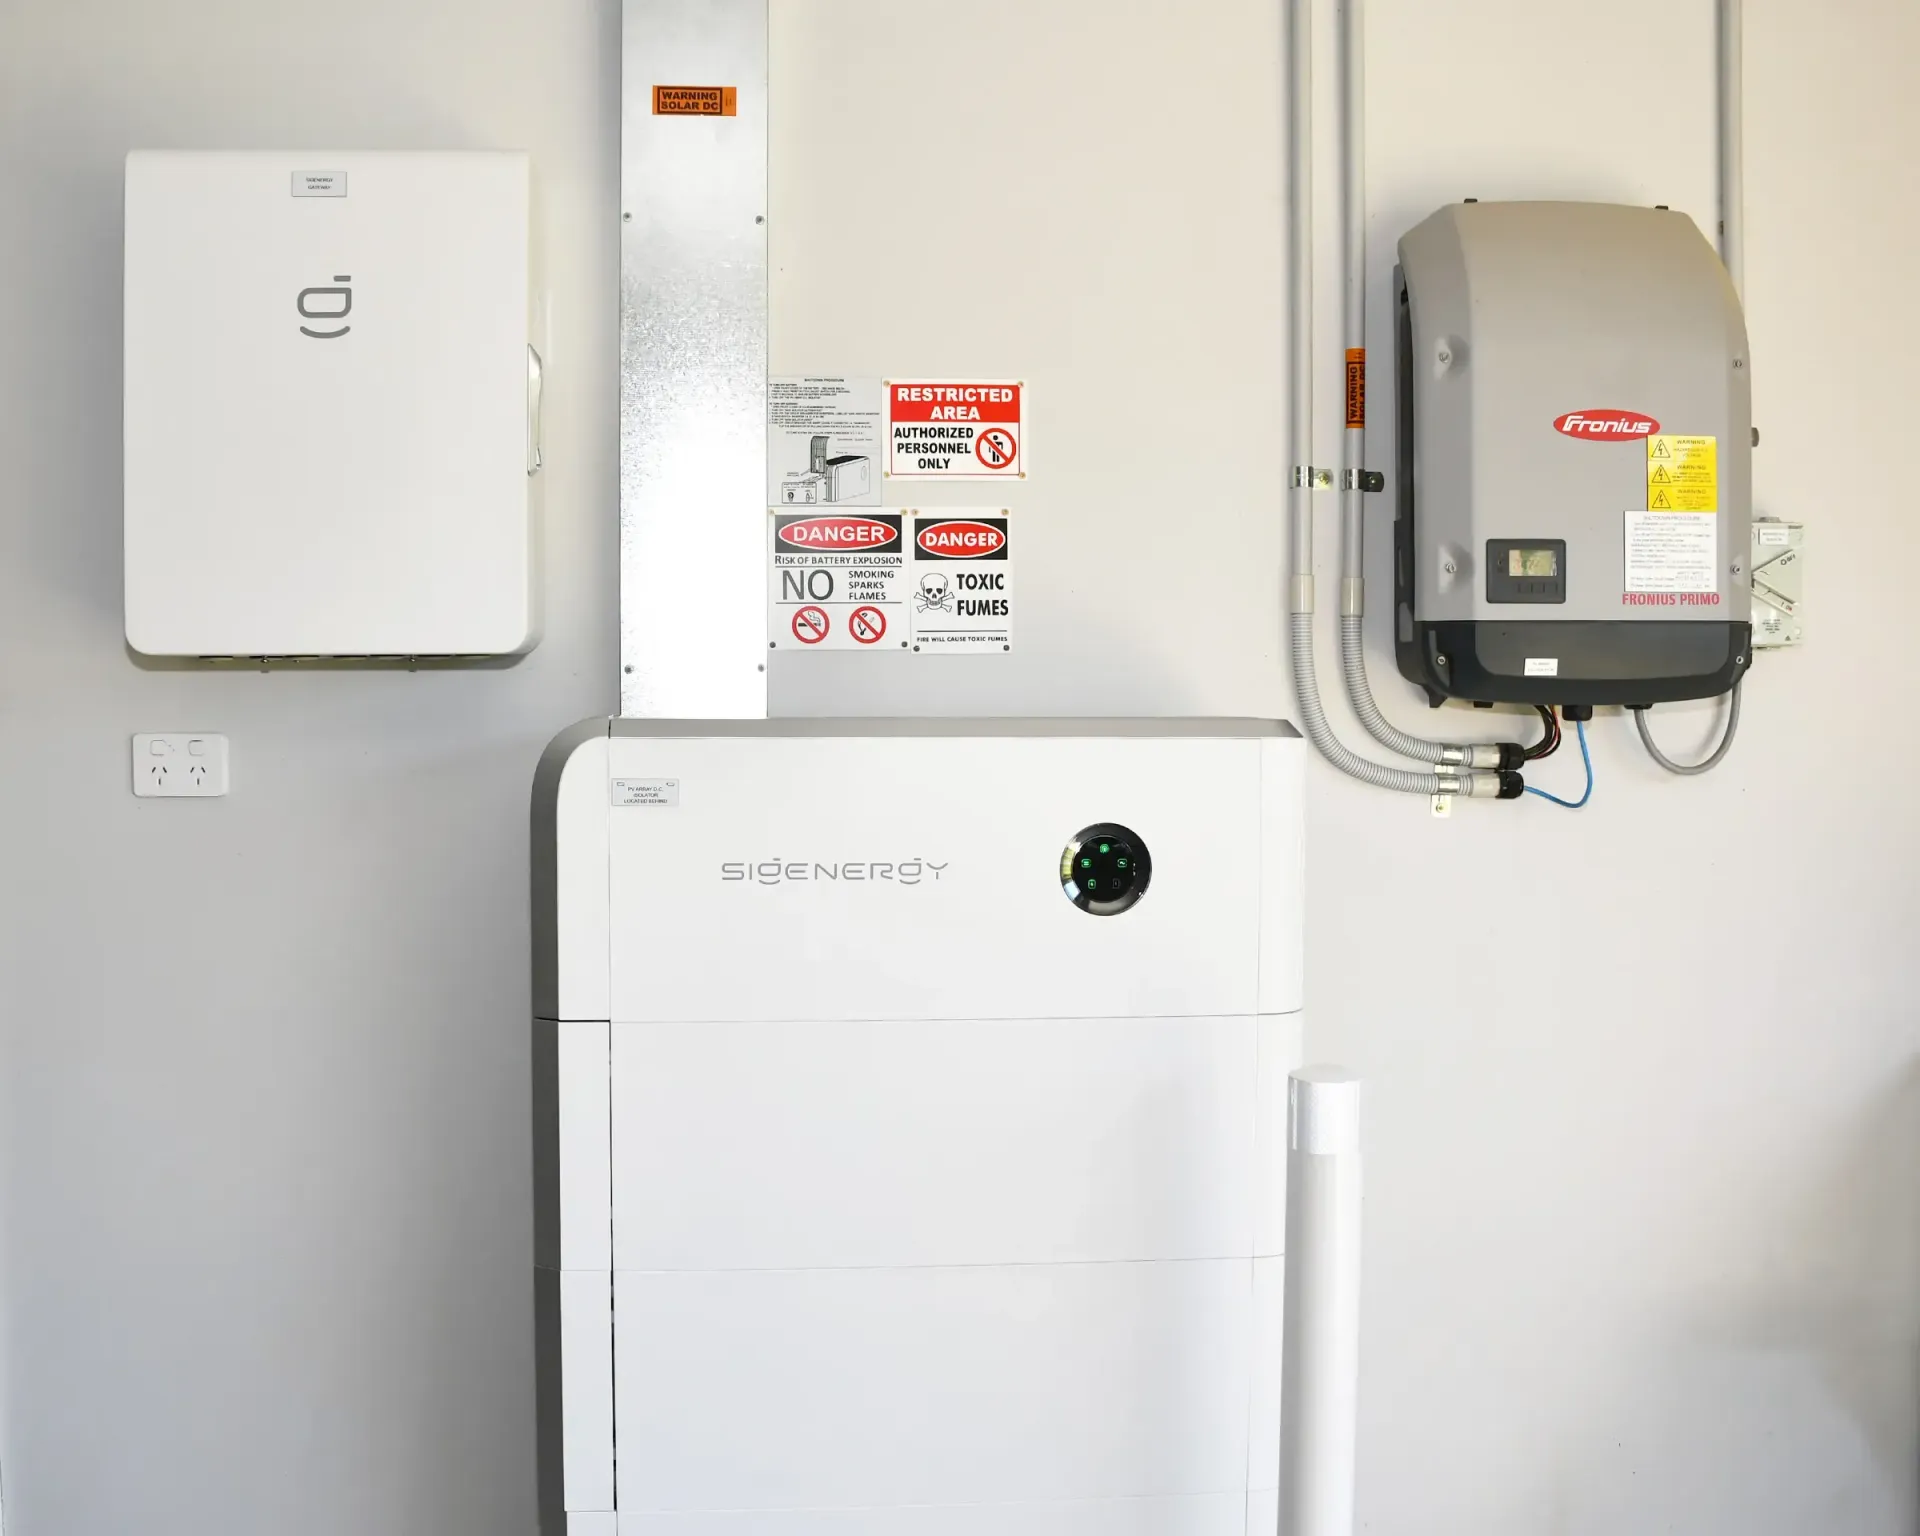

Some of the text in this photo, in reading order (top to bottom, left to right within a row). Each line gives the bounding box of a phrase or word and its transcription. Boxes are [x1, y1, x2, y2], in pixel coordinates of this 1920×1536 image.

[662, 91, 718, 100] WARNING
[661, 101, 718, 110] SOLAR DC
[897, 388, 1013, 402] RESTRICTED
[1350, 366, 1358, 419] WARNING
[930, 406, 981, 420] AREA
[1562, 415, 1652, 433] Fronius
[894, 427, 974, 438] AUTHORIZED
[897, 443, 972, 454] PERSONNEL
[918, 458, 951, 469] ONLY
[793, 526, 885, 541] DANGER
[926, 532, 998, 547] DANGER
[774, 555, 796, 564] RISK
[849, 570, 894, 579] SMOKING
[782, 569, 834, 600] NO
[849, 581, 884, 589] SPARKS
[956, 574, 1004, 590] TOXIC
[849, 592, 886, 600] FLAMES
[1622, 593, 1720, 605] FRONIUS PRIMO
[957, 600, 1008, 616] FUMES
